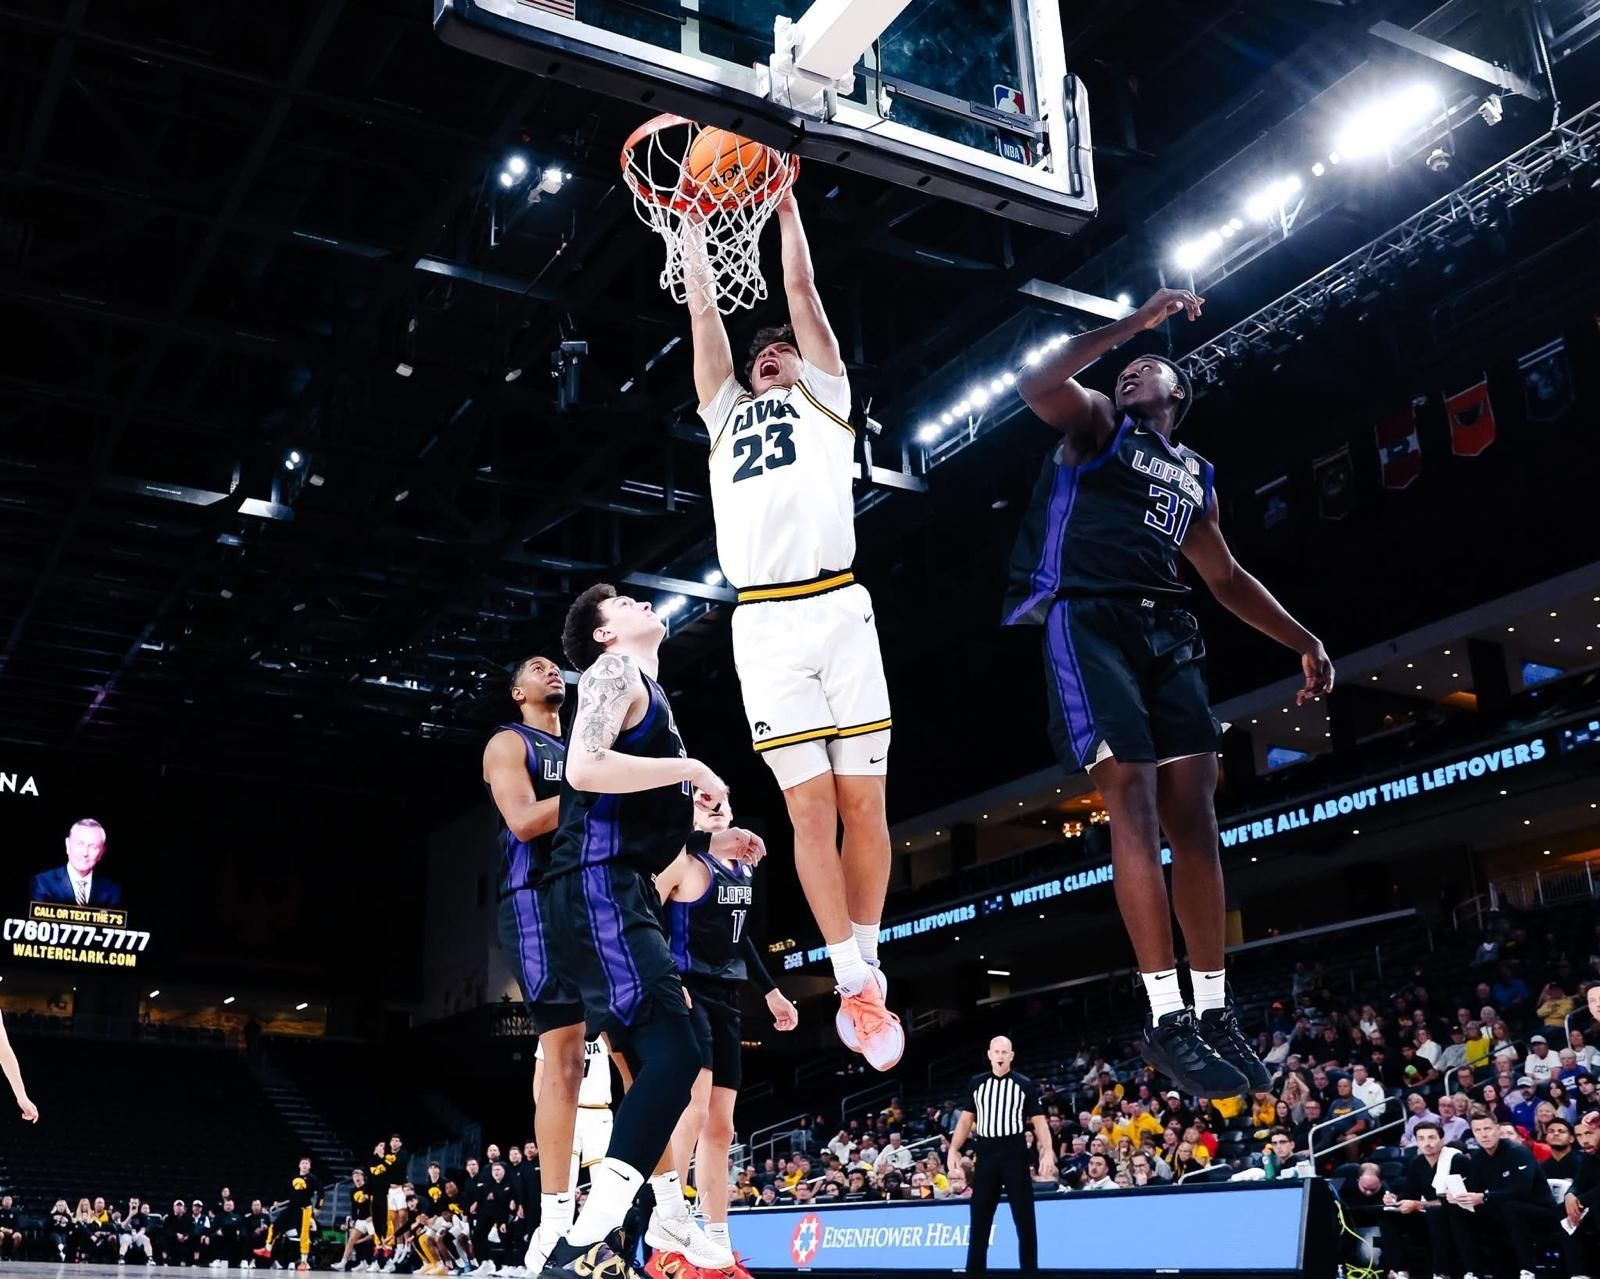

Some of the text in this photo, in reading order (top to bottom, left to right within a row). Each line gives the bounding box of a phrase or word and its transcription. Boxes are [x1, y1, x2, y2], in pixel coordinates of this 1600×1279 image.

[1003, 143, 1020, 160] NBA
[733, 422, 797, 484] 23
[1132, 450, 1203, 506] LOPES
[1144, 483, 1195, 546] 31
[1220, 738, 1546, 848] WE'RE ALL ABOUT THE LEFTOVERS
[1011, 880, 1062, 907] WETTER
[34, 906, 123, 925] CALL OR TEXT THE 7'S
[892, 922, 912, 941] THE
[913, 904, 976, 935] LEFTOVERS
[3, 918, 151, 951] (760)777-7777
[13, 943, 137, 967] WALTERCLARK.COM
[822, 1223, 997, 1248] EISENHOWER HEAL
